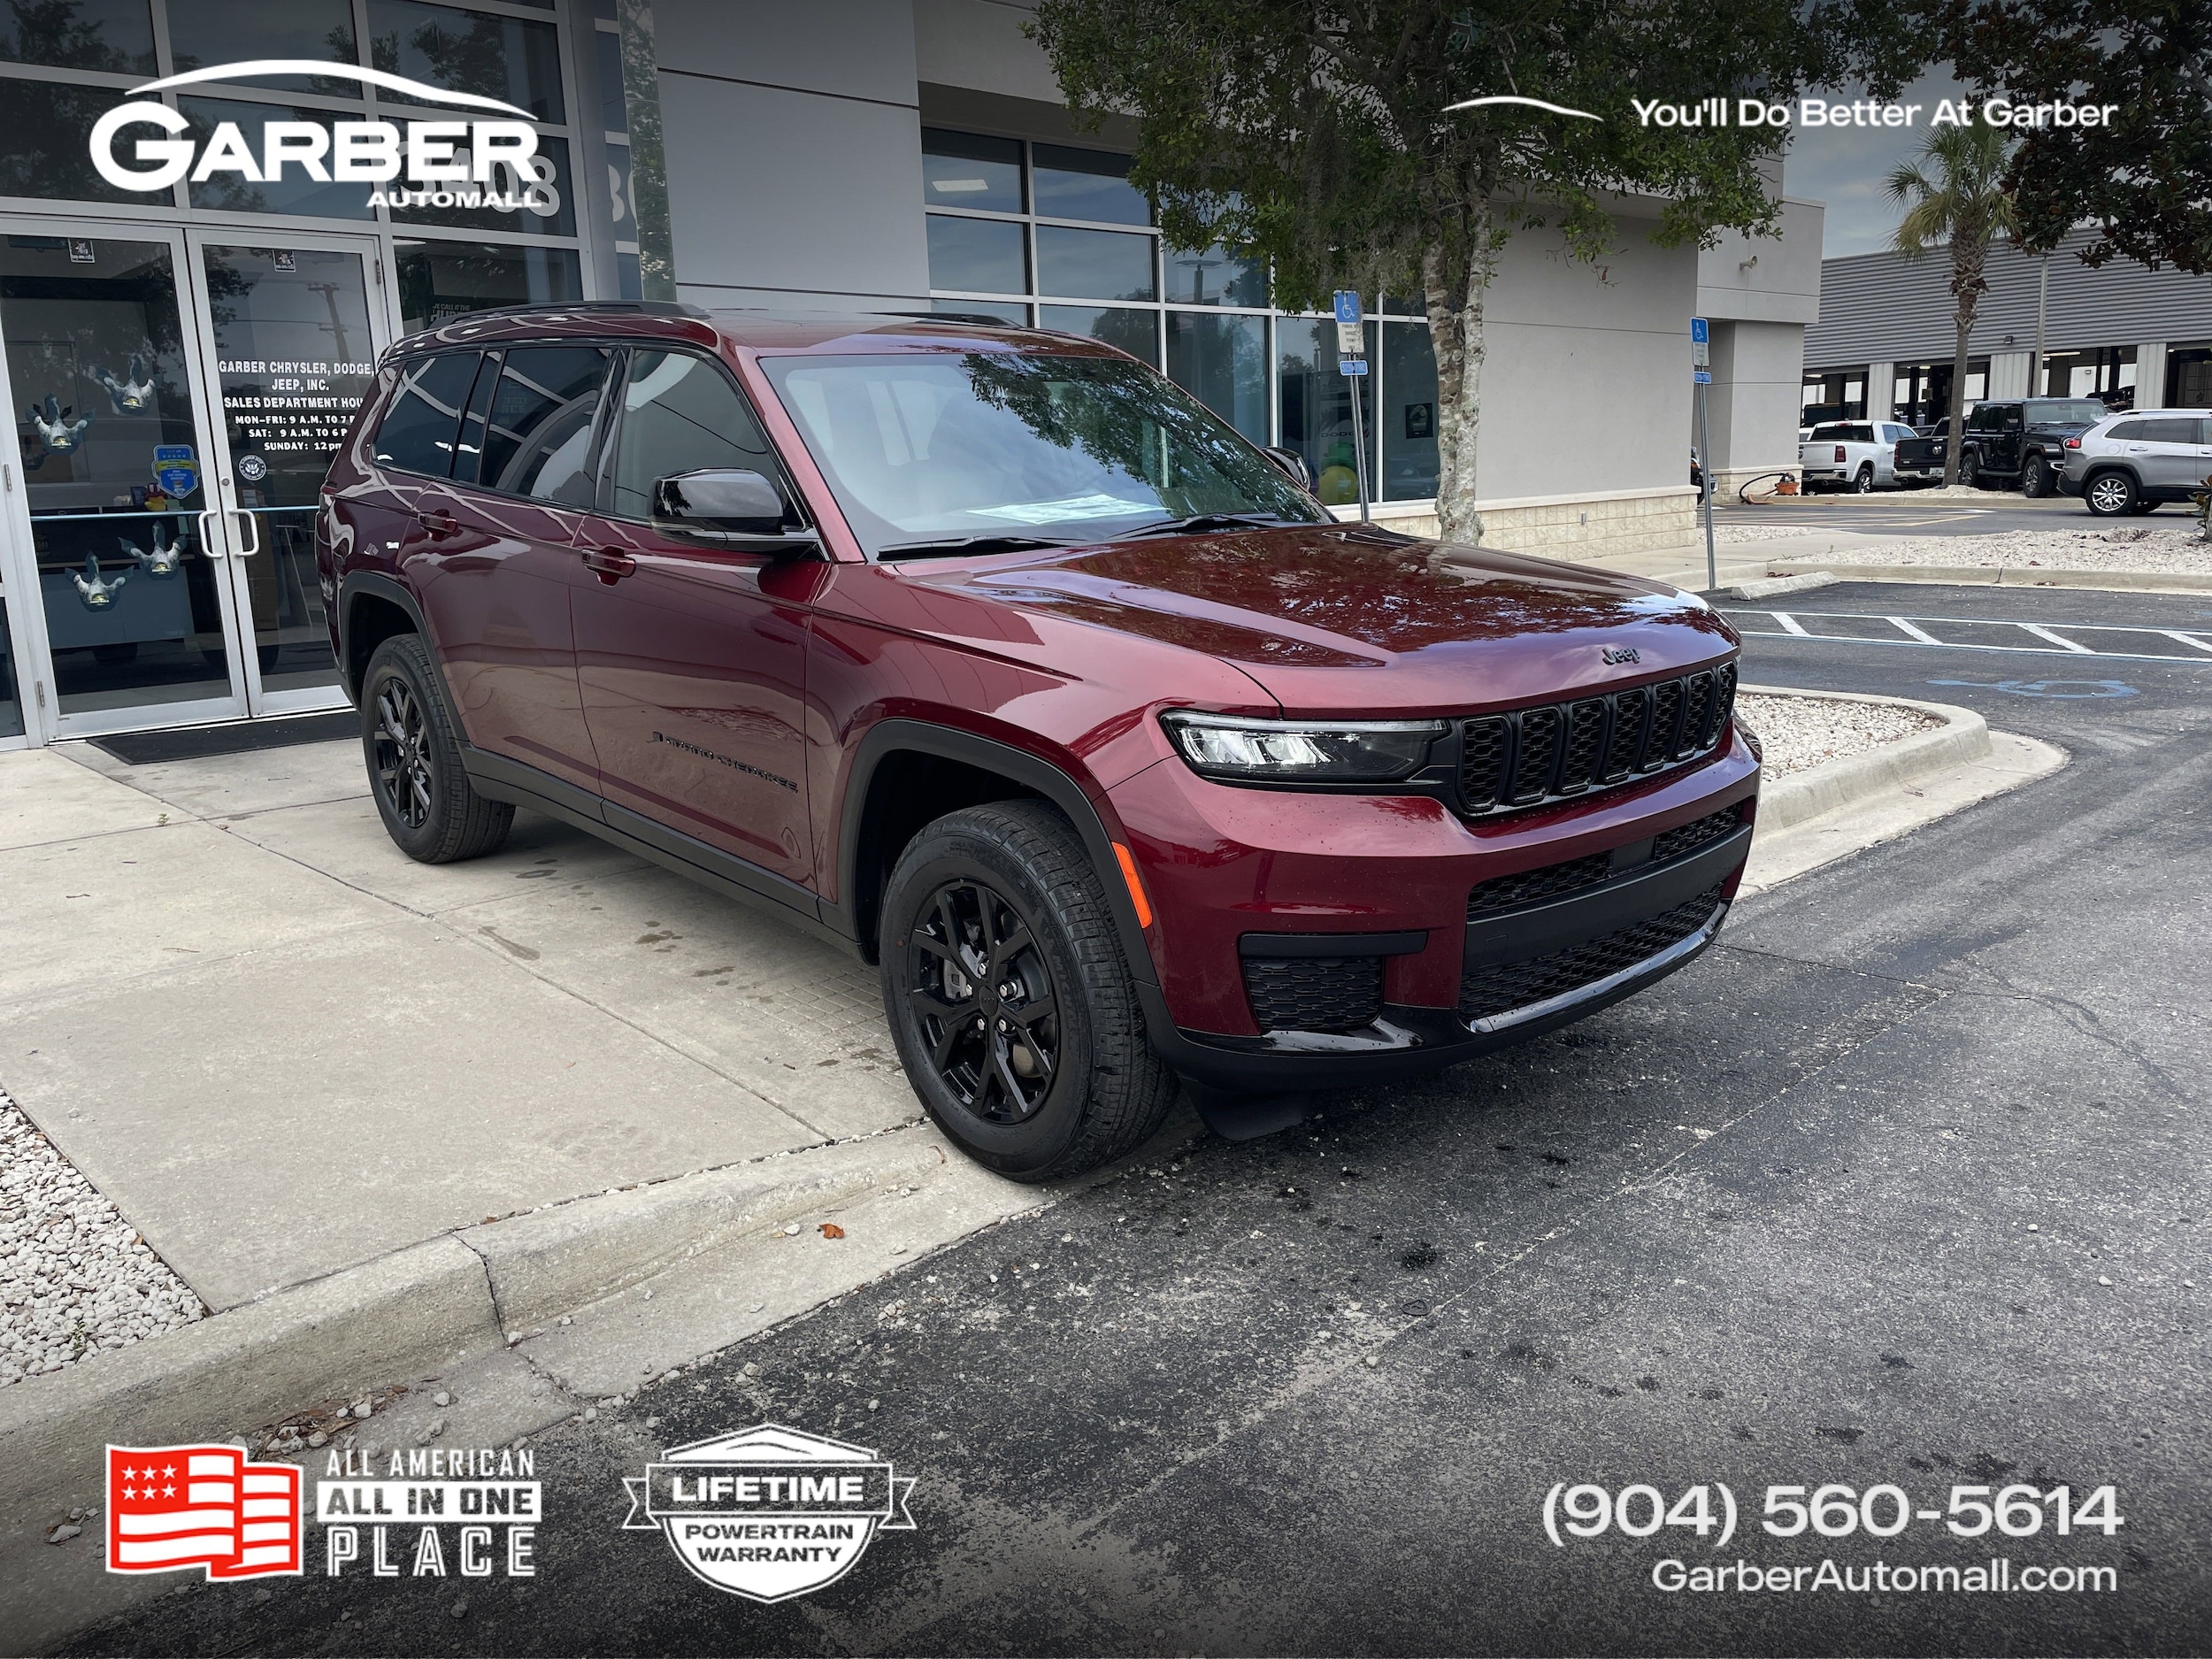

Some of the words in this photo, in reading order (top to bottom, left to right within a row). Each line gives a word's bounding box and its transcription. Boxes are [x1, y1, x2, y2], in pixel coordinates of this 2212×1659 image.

[219, 360, 266, 373] GARBER
[269, 361, 331, 377] CHRYSLER,
[334, 362, 374, 377] DODGE,
[272, 378, 303, 393] JEEP,
[306, 379, 330, 391] INC.
[224, 396, 262, 408] SALES
[263, 396, 338, 408] DEPARTMENT
[288, 415, 296, 425] 9
[300, 415, 323, 424] A.M.
[325, 415, 338, 424] TO
[341, 415, 347, 424] 7
[249, 428, 272, 438] SAT:
[280, 428, 287, 438] 9
[290, 428, 314, 437] A.M.
[316, 428, 329, 437] TO
[332, 428, 339, 437] 6
[264, 442, 309, 451] SUNDAY:
[1601, 646, 1641, 666] Jeep
